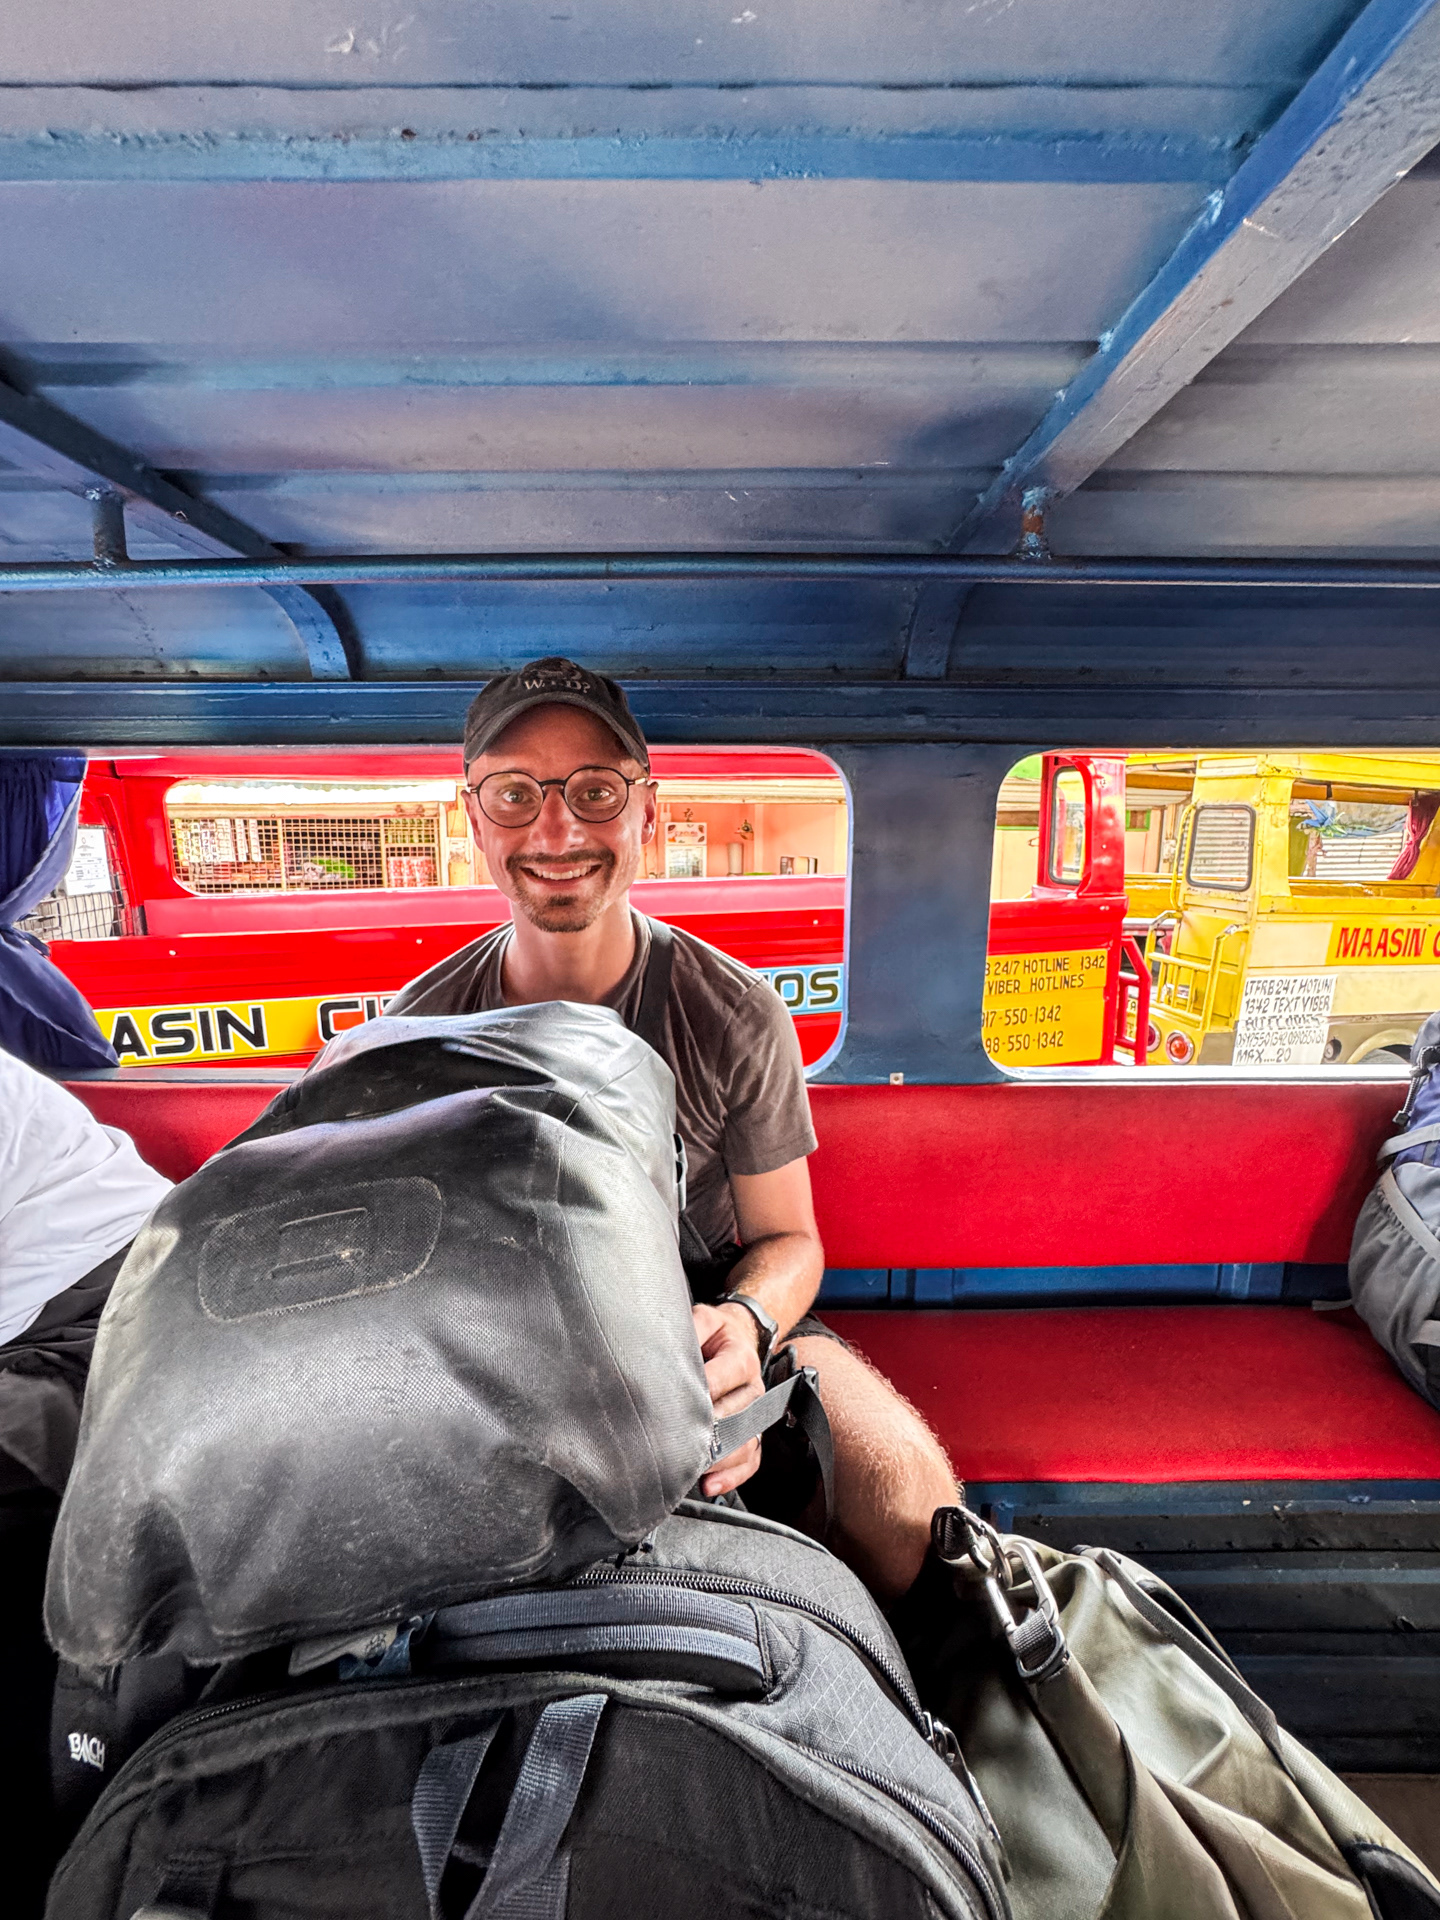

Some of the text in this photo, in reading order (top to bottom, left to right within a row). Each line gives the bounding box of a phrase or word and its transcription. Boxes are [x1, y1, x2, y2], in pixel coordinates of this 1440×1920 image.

[1335, 927, 1427, 958] MAASIN
[993, 961, 1020, 976] 24/7
[1023, 957, 1070, 974] HOTLINE
[1080, 955, 1105, 970] 1342
[1030, 974, 1085, 992] HOTLINES
[1244, 979, 1275, 996] LTFRB
[1245, 995, 1330, 1014] 1342 TEXT VIBER
[68, 1732, 106, 1772] BACH
